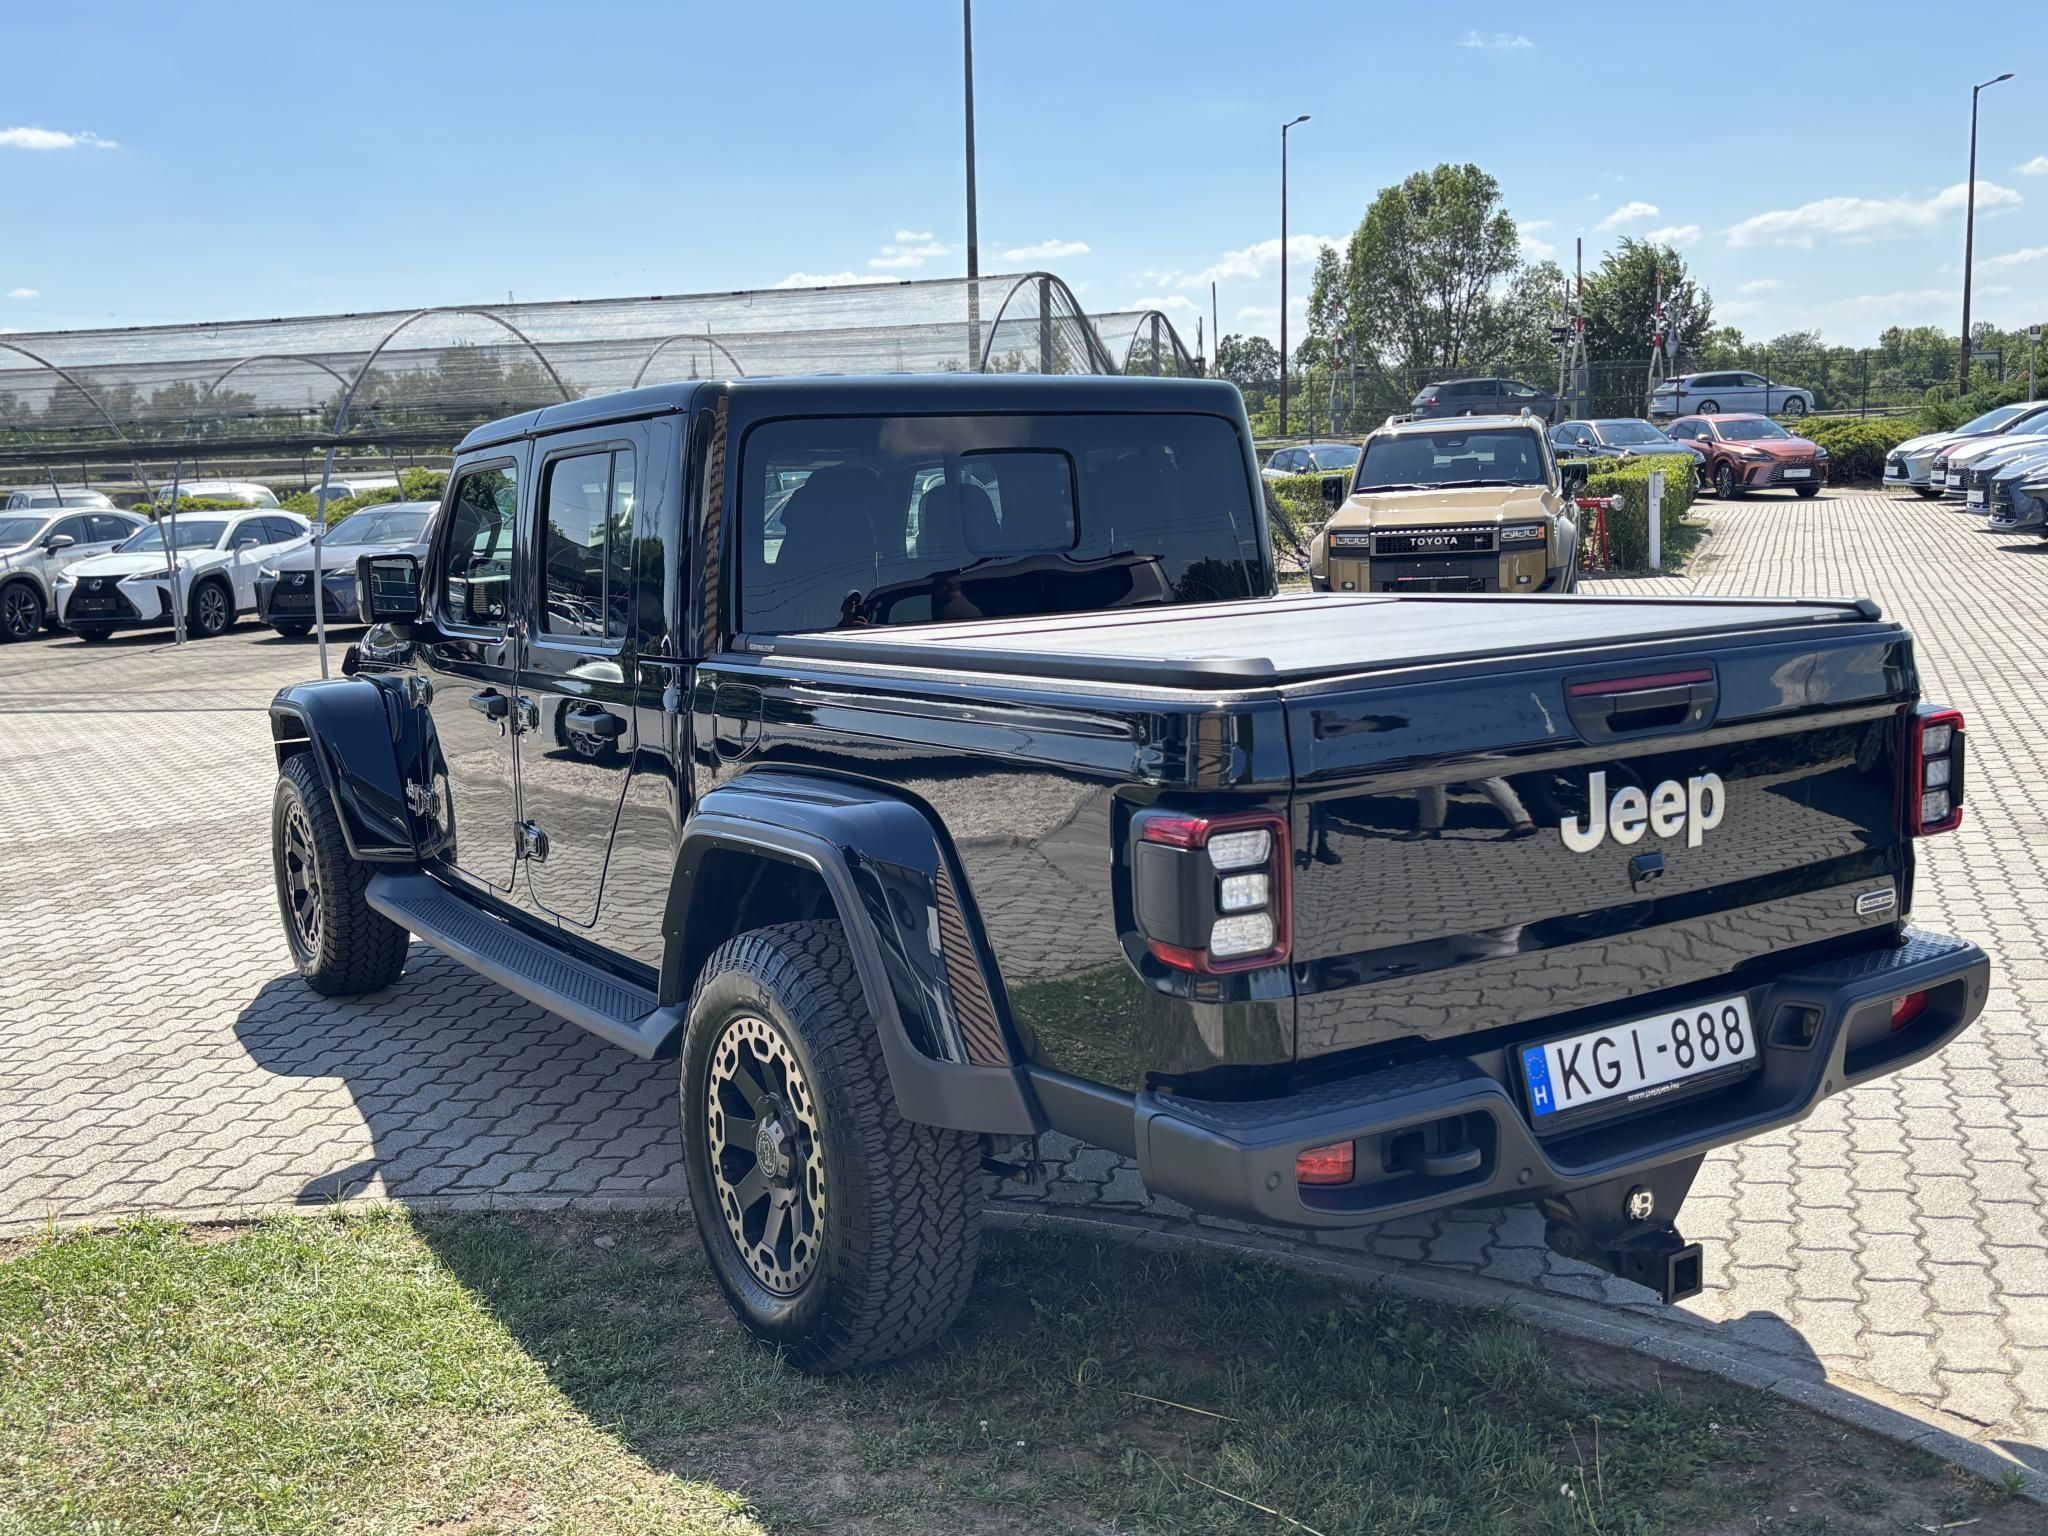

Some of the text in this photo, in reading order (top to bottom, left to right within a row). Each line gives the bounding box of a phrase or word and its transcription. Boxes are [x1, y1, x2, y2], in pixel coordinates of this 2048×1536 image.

[1410, 536, 1458, 546] TOYOTA
[1560, 770, 1726, 854] Jeep
[1557, 1005, 1745, 1101] KGI-888
[1534, 1085, 1549, 1106] H
